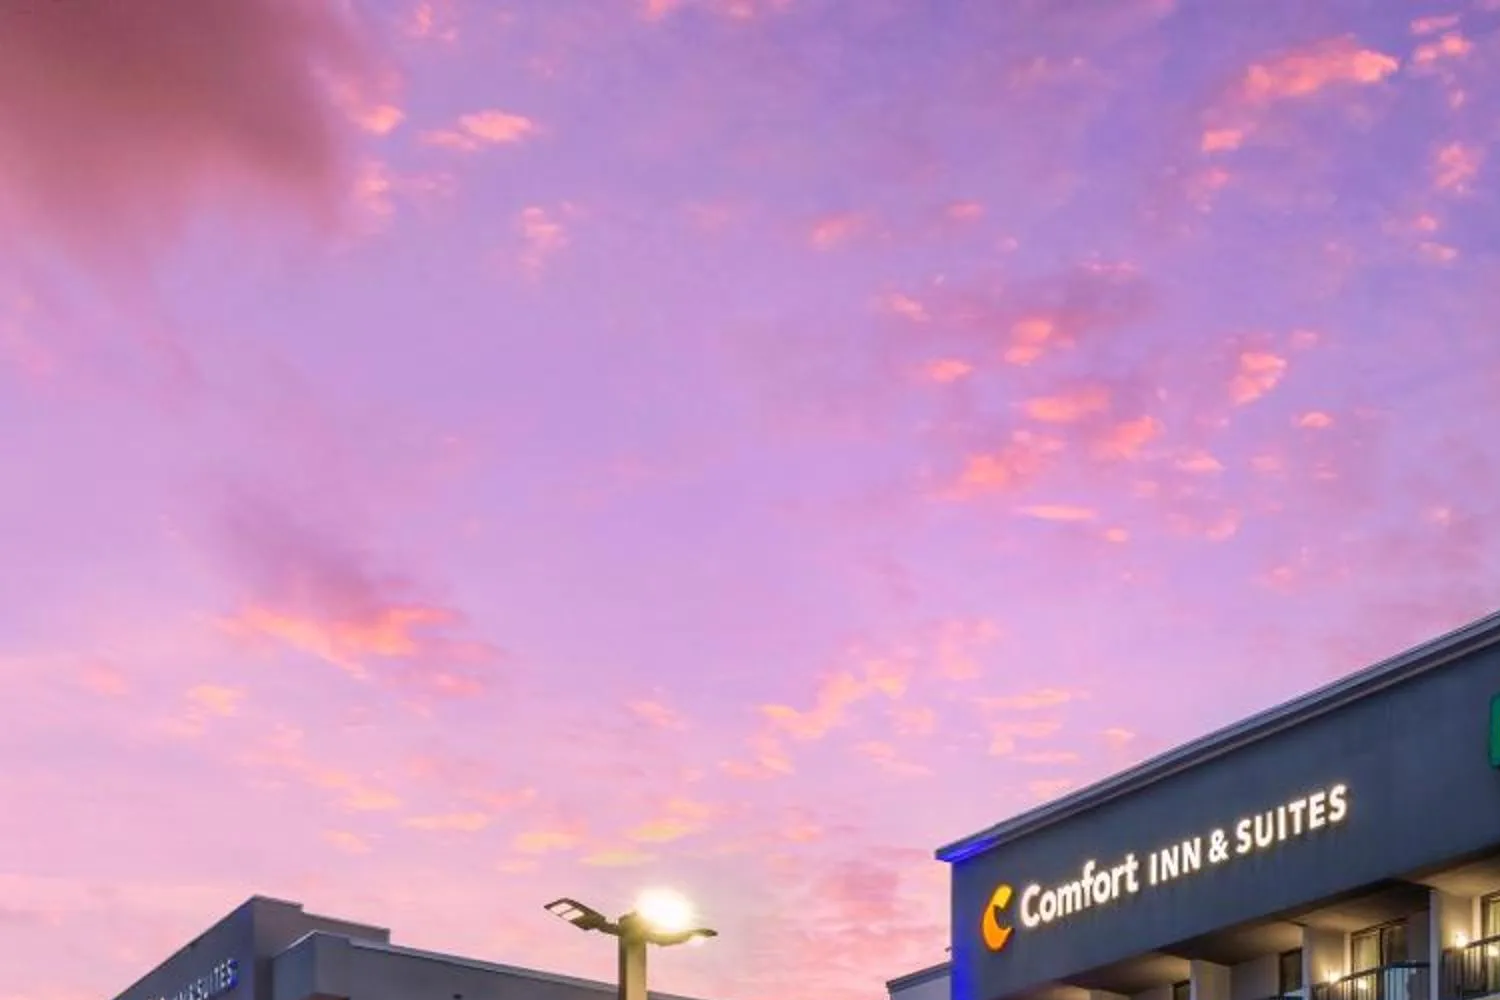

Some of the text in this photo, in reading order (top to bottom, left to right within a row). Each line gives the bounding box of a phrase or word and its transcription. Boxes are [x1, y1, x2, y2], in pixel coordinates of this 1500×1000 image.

[1019, 851, 1140, 928] Comfort
[1149, 837, 1202, 886] INN
[1208, 828, 1230, 864] &
[1236, 783, 1348, 854] SUITES
